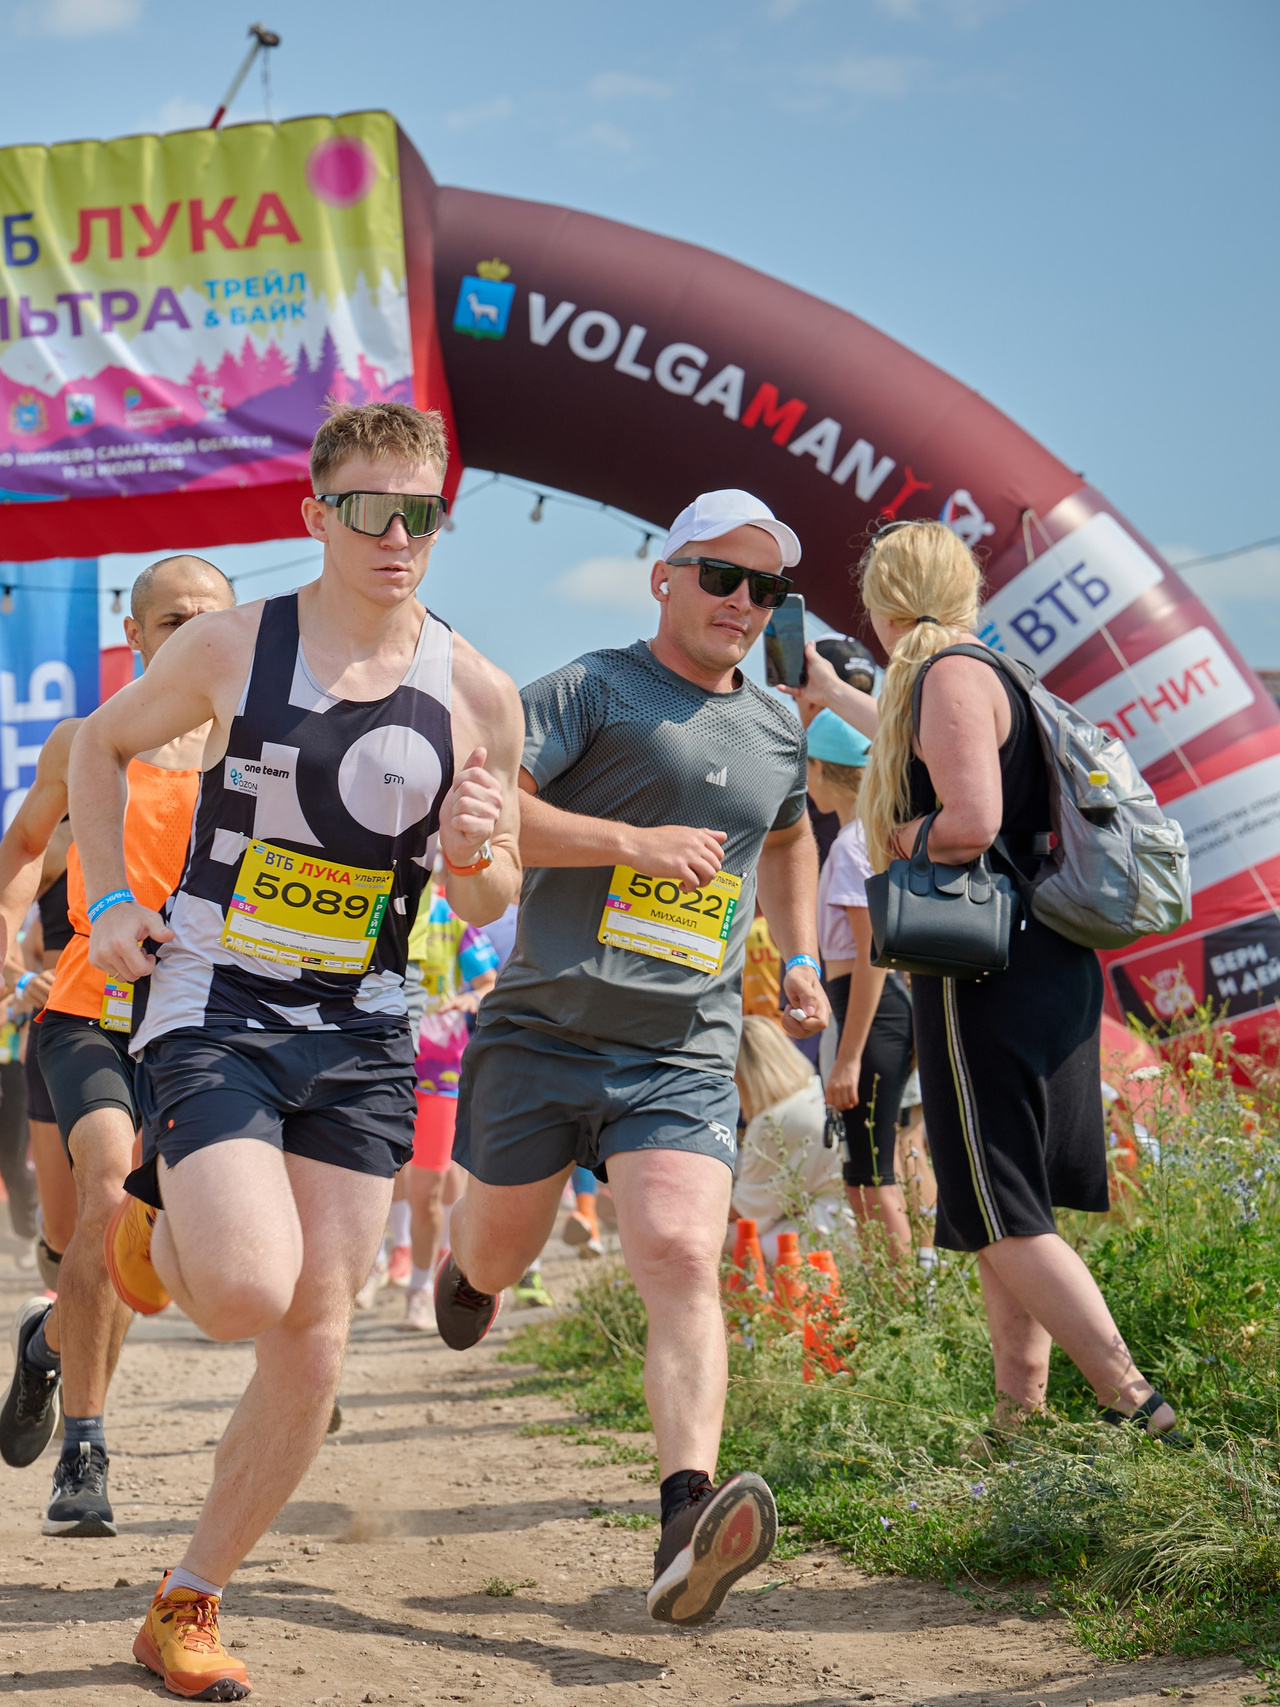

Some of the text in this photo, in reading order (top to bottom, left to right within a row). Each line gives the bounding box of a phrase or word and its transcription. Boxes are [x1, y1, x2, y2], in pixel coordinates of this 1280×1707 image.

[70, 192, 302, 263] ЛУКА
[203, 269, 306, 301] ТРЕЙЛ
[204, 299, 307, 328] & БАЙК
[1009, 561, 1112, 656] ВТБ
[244, 764, 290, 779] one team
[265, 851, 386, 885] ВТБ ЛУКА УЛЬТРА
[713, 876, 736, 887] ЛЬТРА
[253, 872, 369, 919] 5089
[628, 873, 723, 919] 5022
[368, 896, 386, 935] ТРЕЙЛ
[650, 909, 697, 928] МИХАИЛ
[721, 900, 735, 938] ТРЕЙЛ
